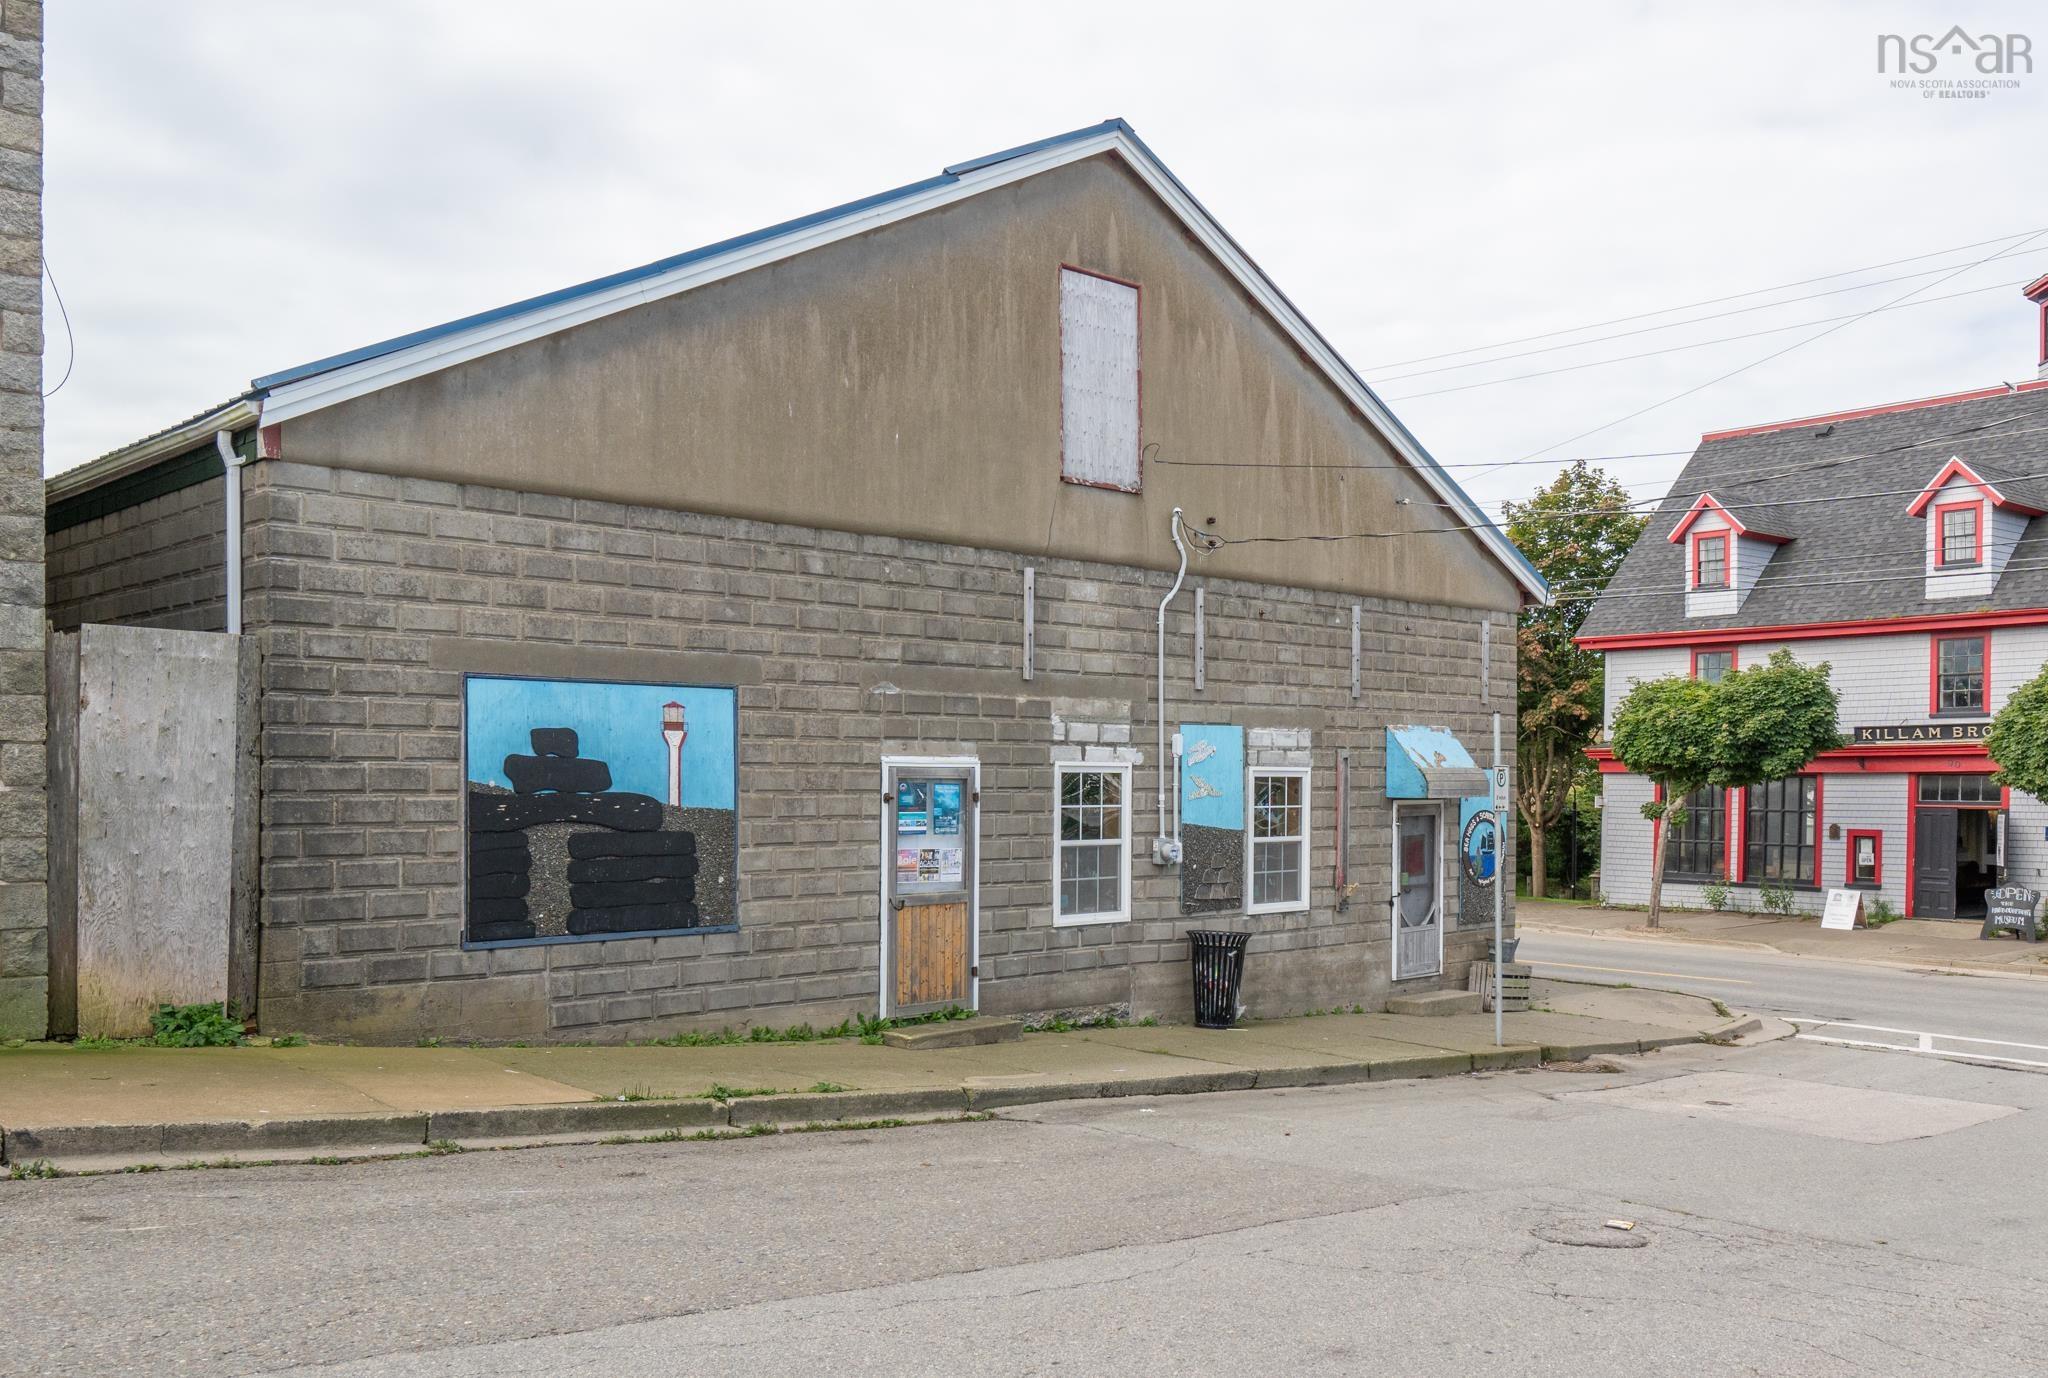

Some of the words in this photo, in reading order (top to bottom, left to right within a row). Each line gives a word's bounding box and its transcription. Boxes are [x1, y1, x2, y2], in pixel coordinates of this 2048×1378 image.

[1862, 727, 1941, 740] KILLAM
[1996, 887, 2031, 901] OPEN
[1994, 915, 2025, 926] MUSEUM
